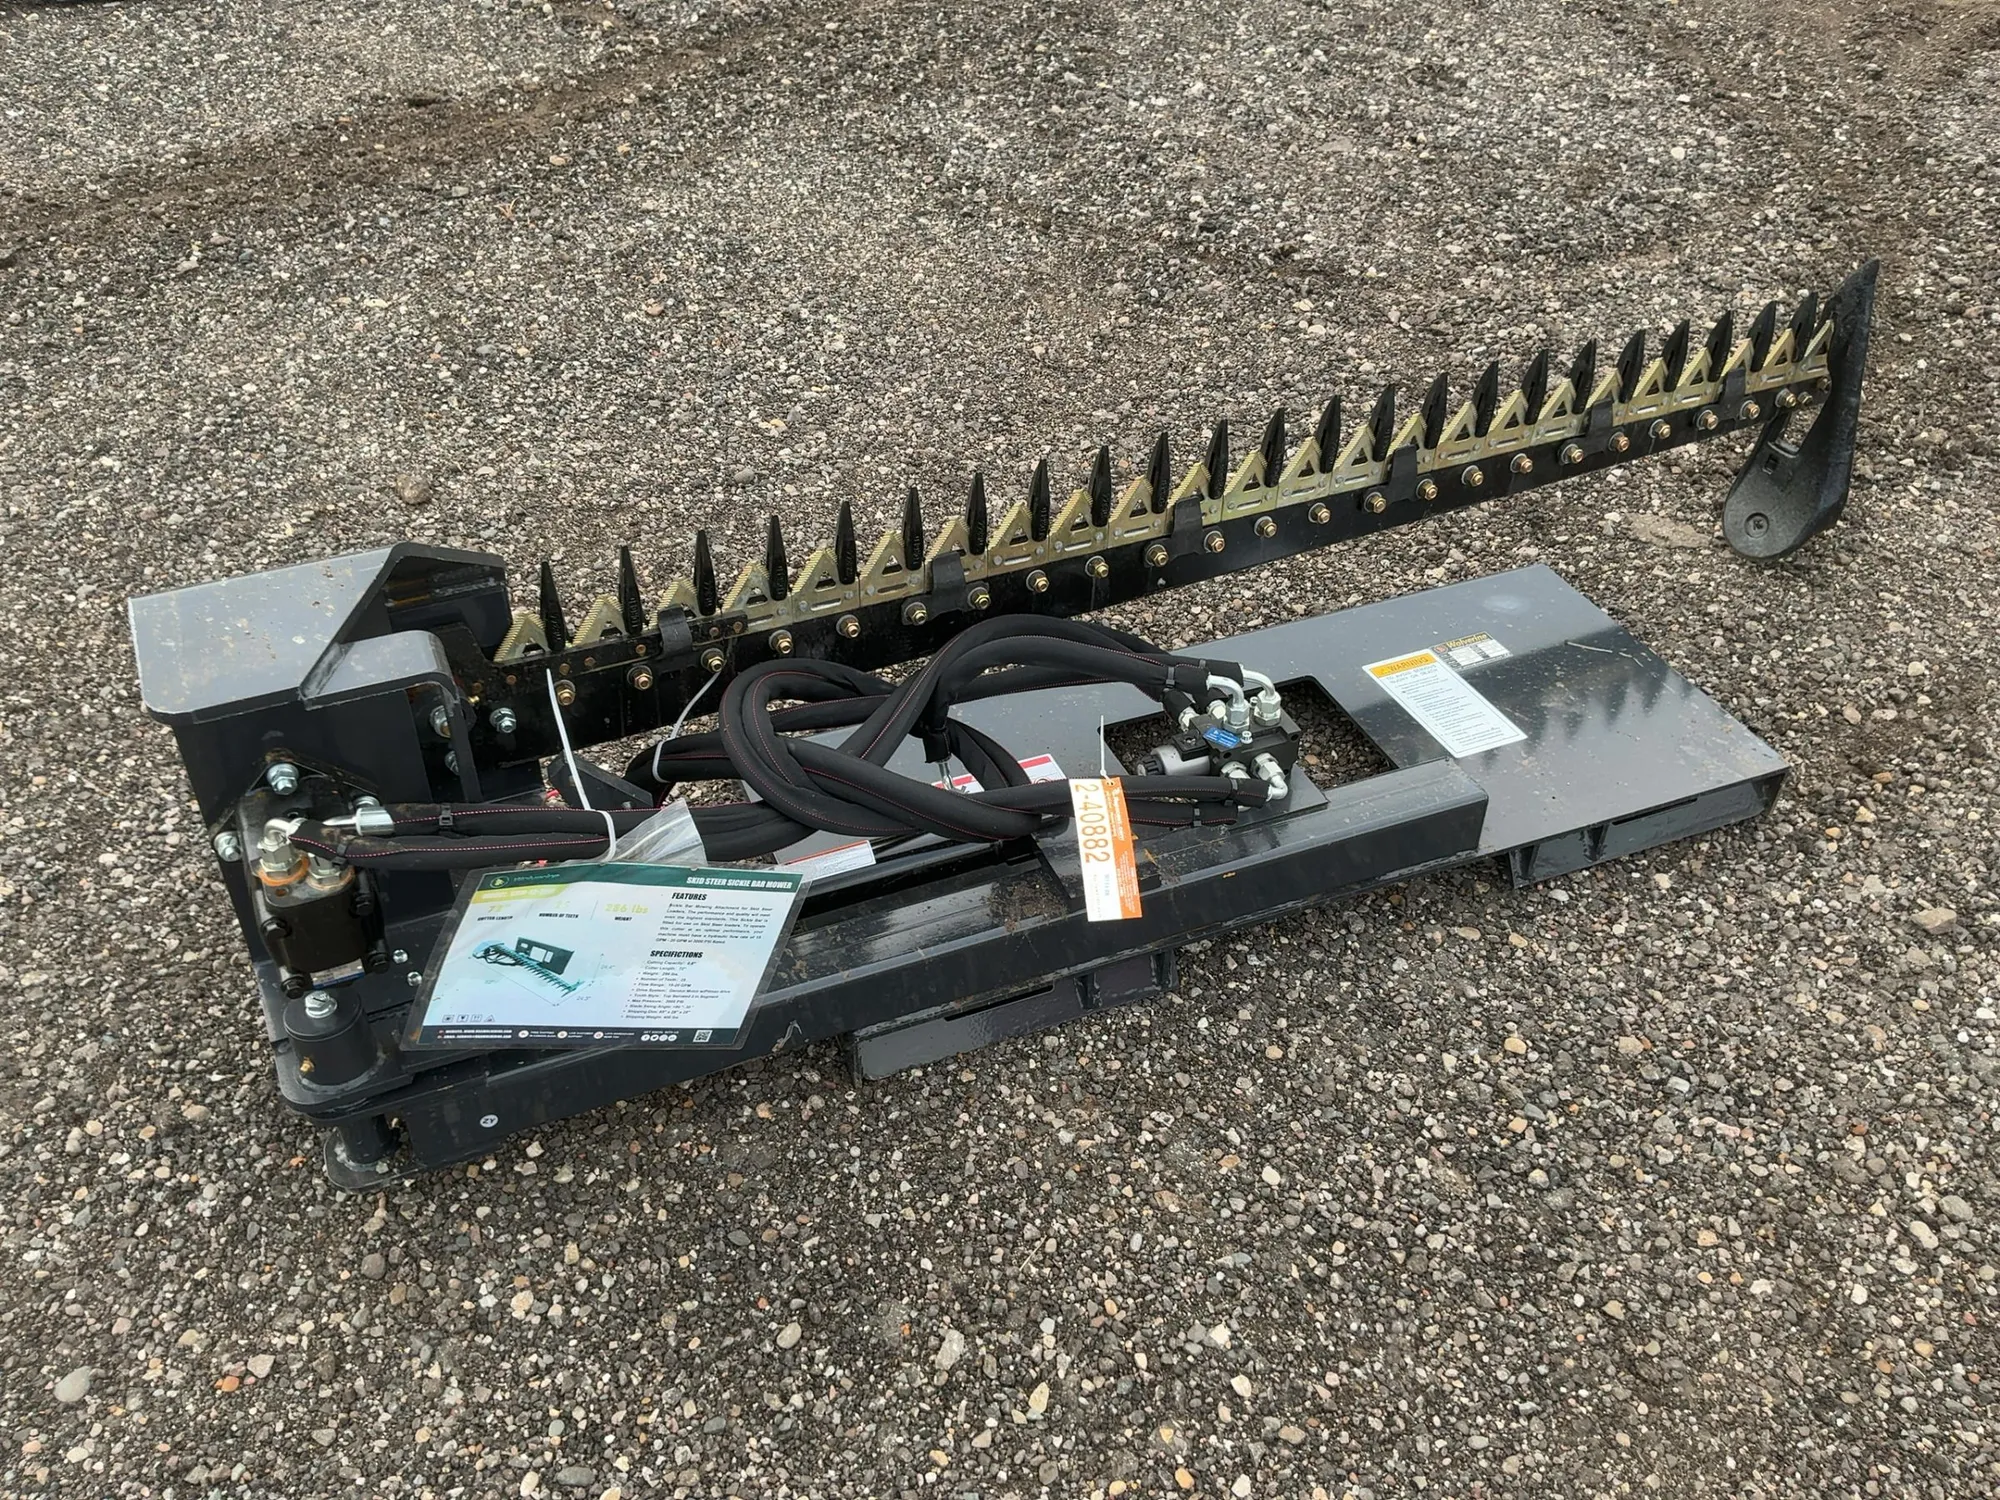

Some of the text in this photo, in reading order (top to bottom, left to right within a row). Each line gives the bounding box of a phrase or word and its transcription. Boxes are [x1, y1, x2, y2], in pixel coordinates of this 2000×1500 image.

[1447, 634, 1488, 649] Wolverine
[1390, 657, 1429, 672] WARNING
[1075, 784, 1110, 863] 2-40882
[705, 878, 726, 886] STEER
[751, 880, 766, 888] BAR
[672, 892, 707, 900] FEATURES
[650, 950, 703, 958] SPECIFICTIONS
